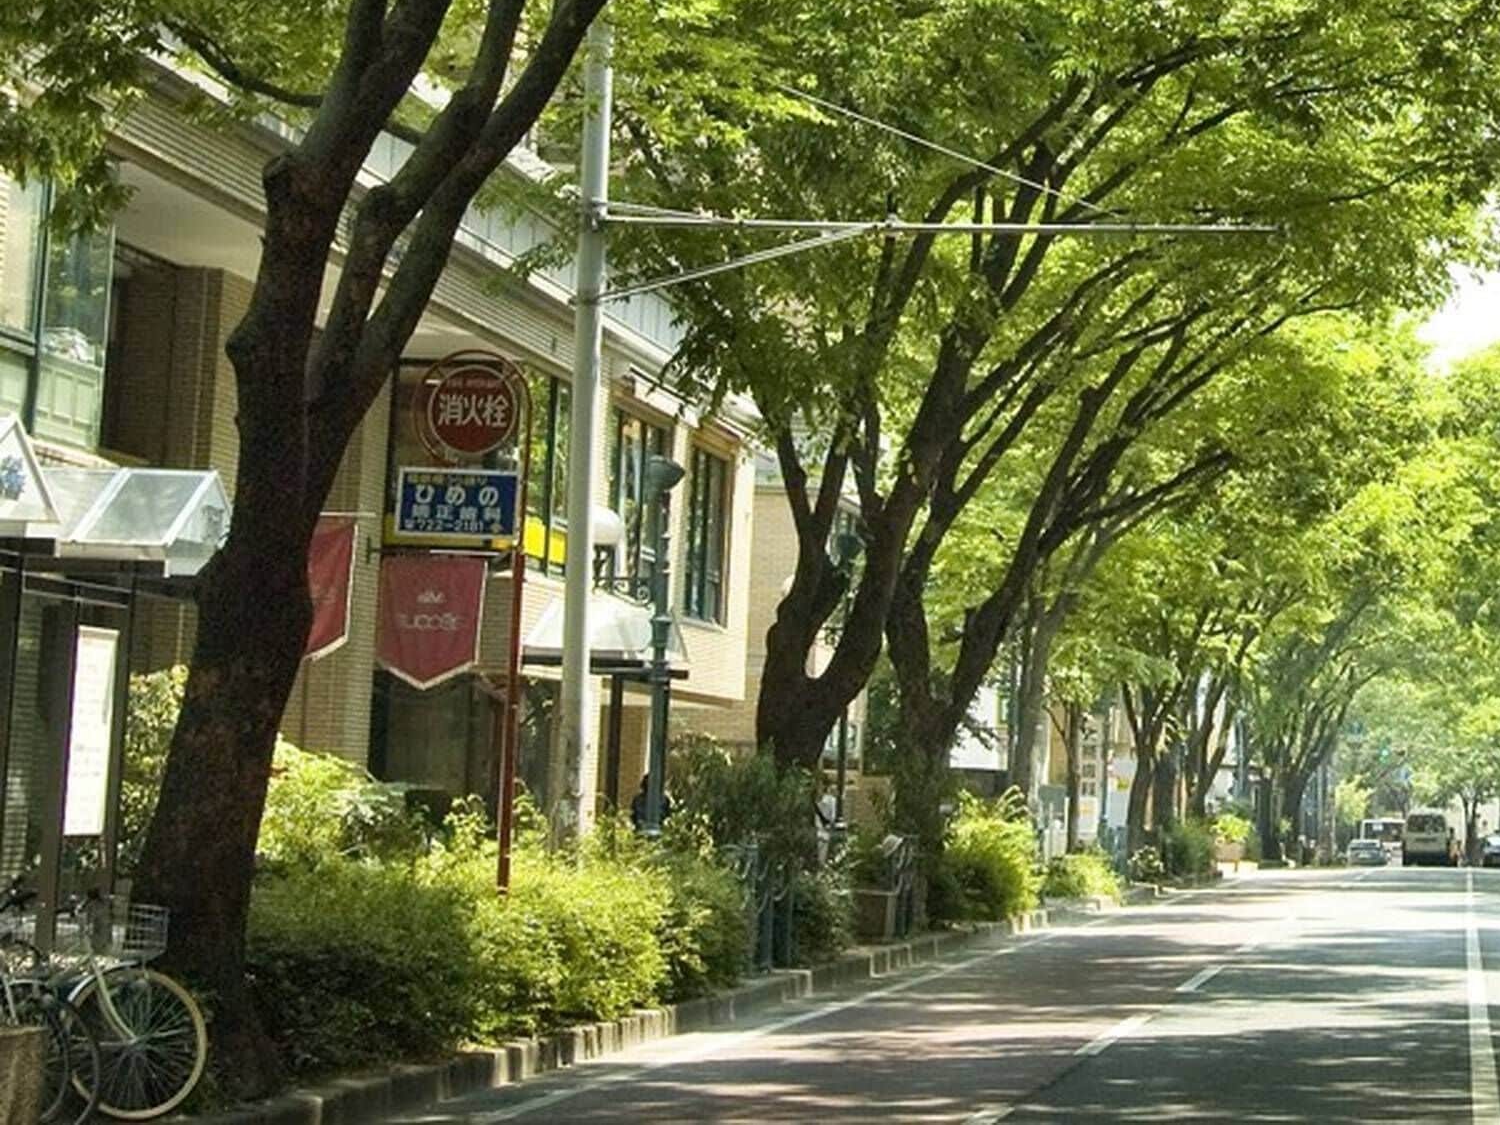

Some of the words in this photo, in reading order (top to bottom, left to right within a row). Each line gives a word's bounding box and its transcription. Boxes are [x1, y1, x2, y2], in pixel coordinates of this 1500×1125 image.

[438, 394, 508, 426] 消火栓
[415, 483, 499, 506] ひめの
